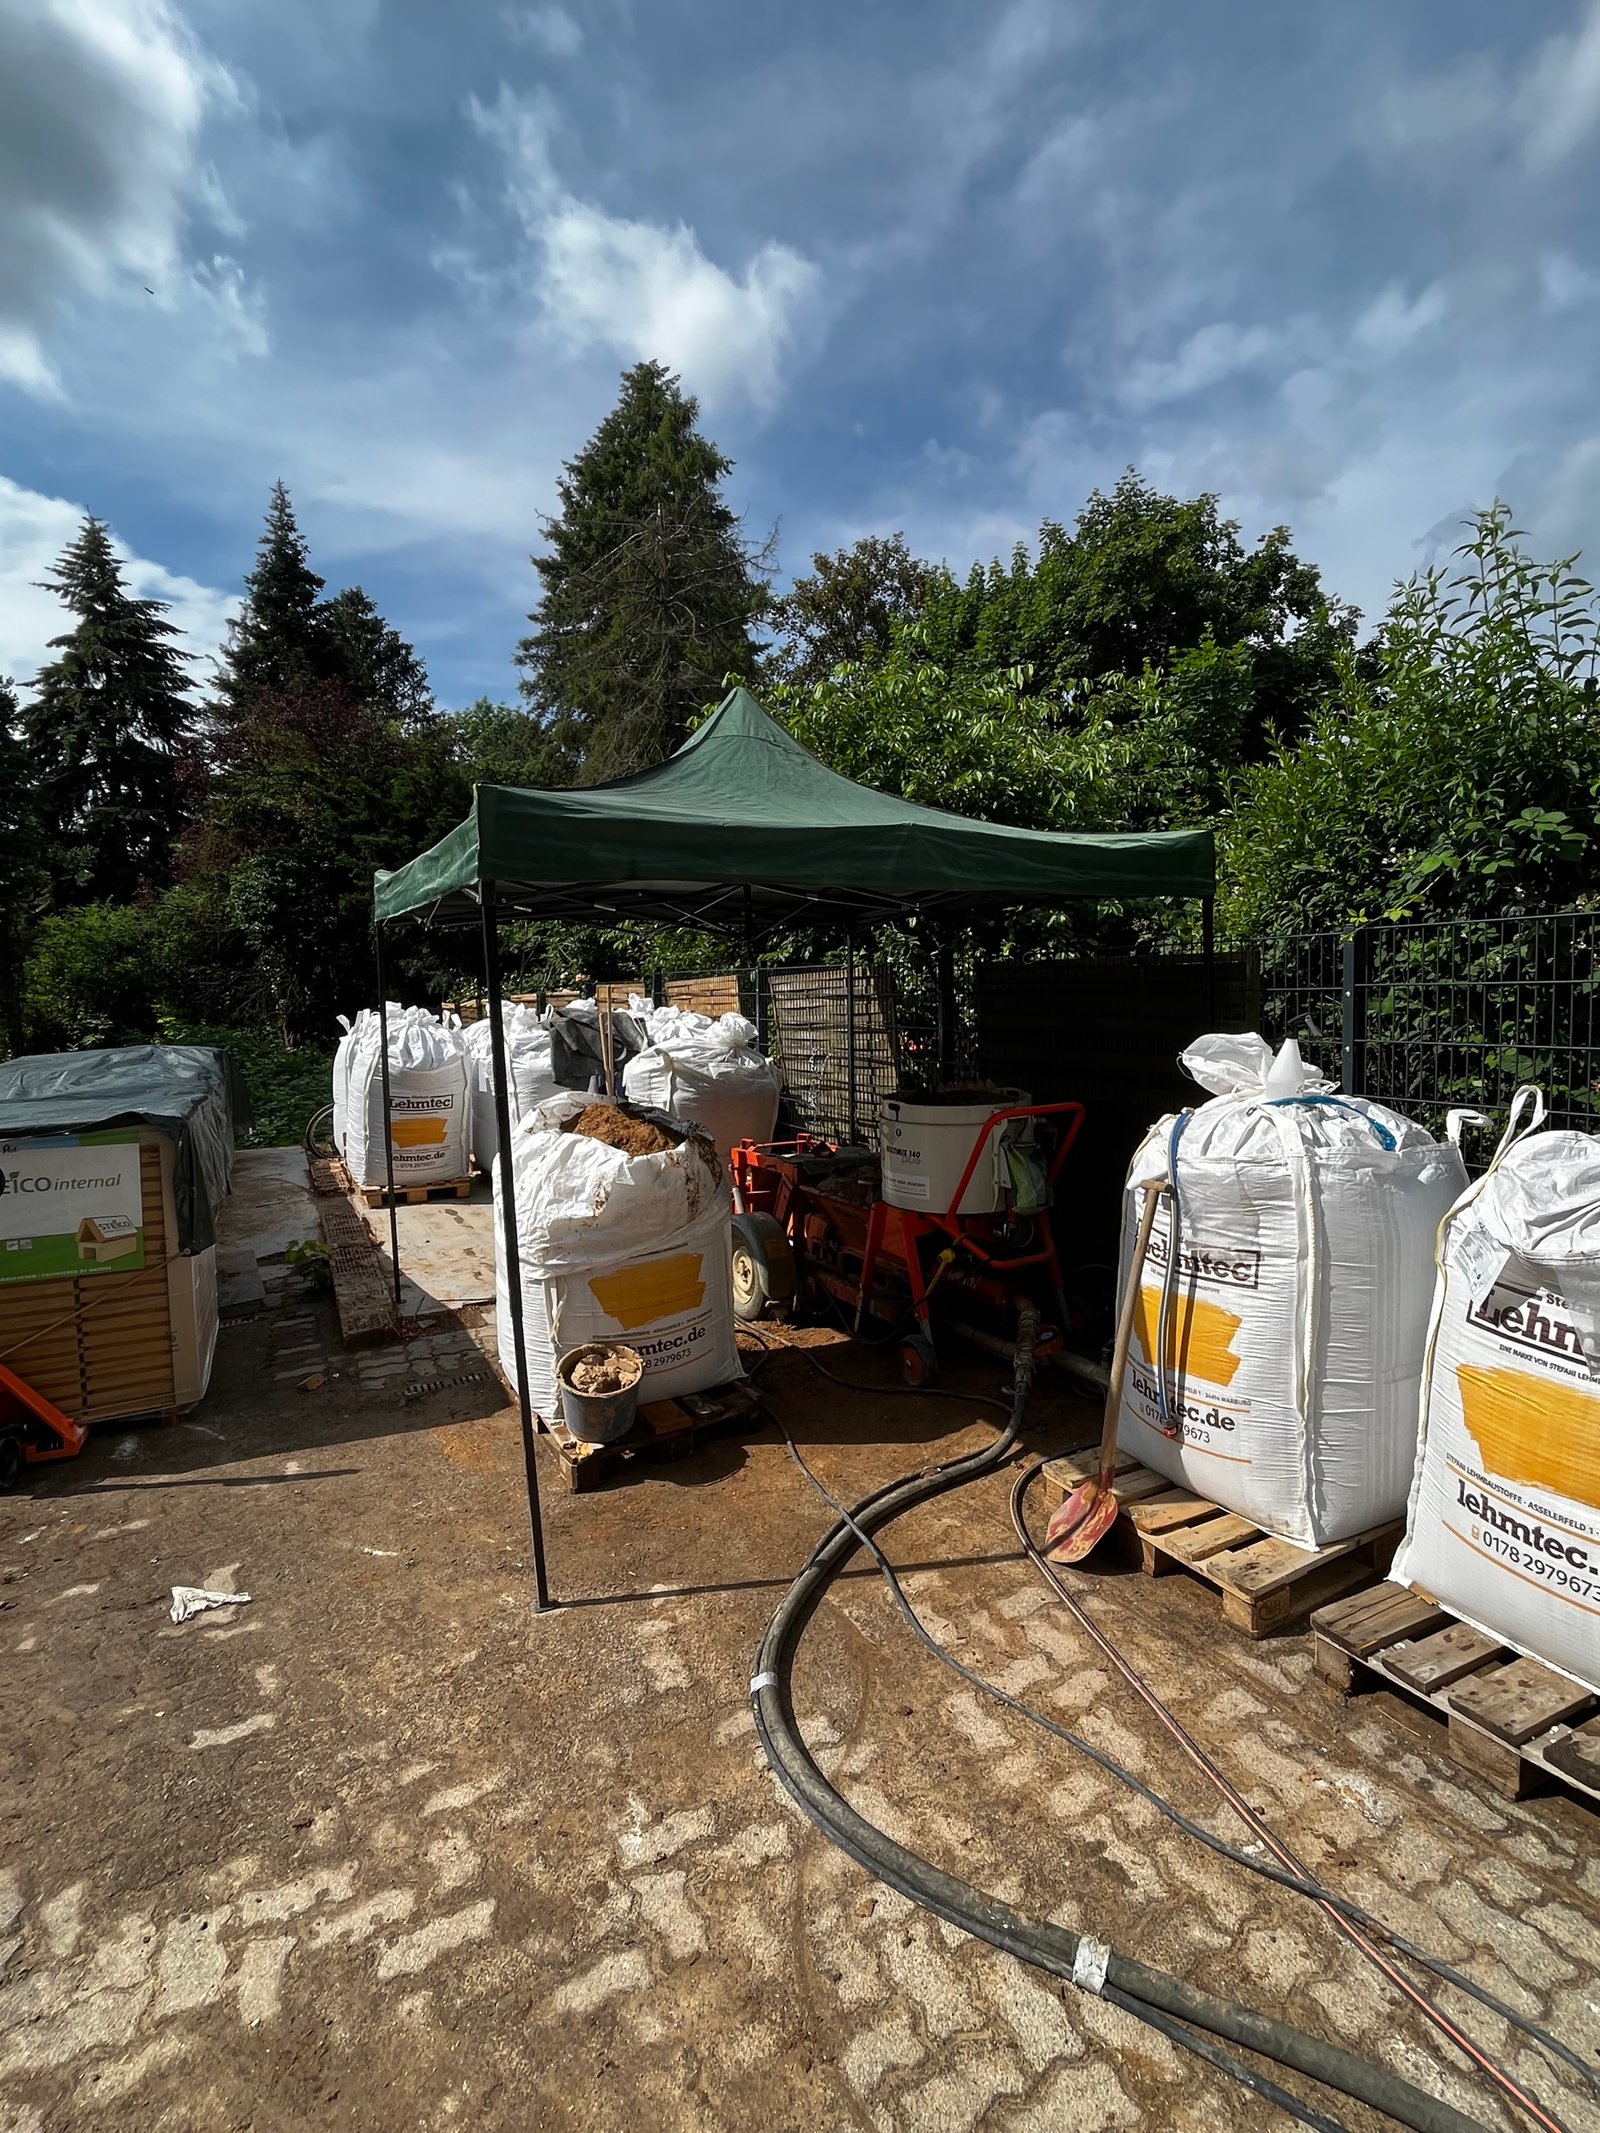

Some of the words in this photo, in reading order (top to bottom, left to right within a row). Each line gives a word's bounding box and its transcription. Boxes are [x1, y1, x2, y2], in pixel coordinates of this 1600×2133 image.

[392, 1151, 446, 1162] ehmtec.de
[909, 1150, 920, 1159] 140
[54, 1173, 121, 1191] internal
[654, 1347, 691, 1367] 2979673
[1512, 1349, 1533, 1362] MARKE
[1534, 1356, 1548, 1367] VON
[1549, 1362, 1577, 1377] STEFANI
[1466, 1466, 1523, 1504] LEHMBAUSTOFFE
[1527, 1501, 1587, 1532] ASSELERFELD
[1483, 1530, 1521, 1563] 0178
[1523, 1552, 1600, 1603] 2979673
